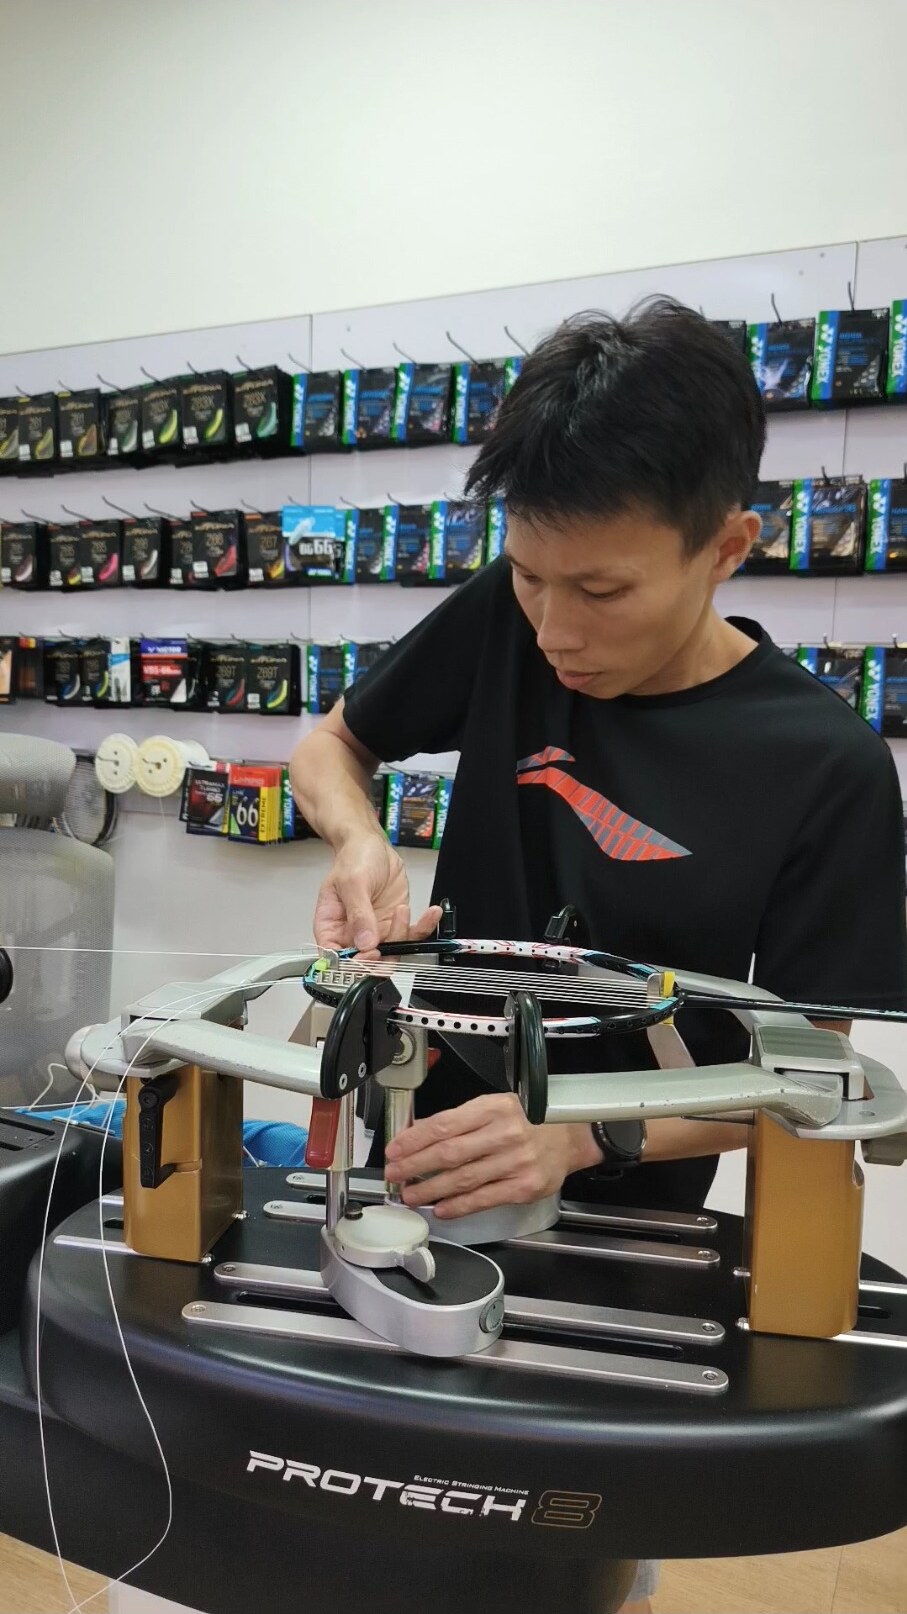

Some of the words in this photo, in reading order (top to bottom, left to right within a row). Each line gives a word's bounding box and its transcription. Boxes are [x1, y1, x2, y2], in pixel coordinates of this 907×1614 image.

[865, 682, 880, 720] YONEX
[236, 796, 259, 827] 66
[284, 797, 293, 826] YONEX
[388, 802, 400, 831] YONEX
[437, 808, 448, 838] YONEX
[246, 1450, 526, 1521] PROTECH
[530, 1489, 603, 1529] 8
[413, 1475, 450, 1486] ELECTRIC
[451, 1480, 494, 1492] STRINGING
[494, 1486, 530, 1496] MACHINE
